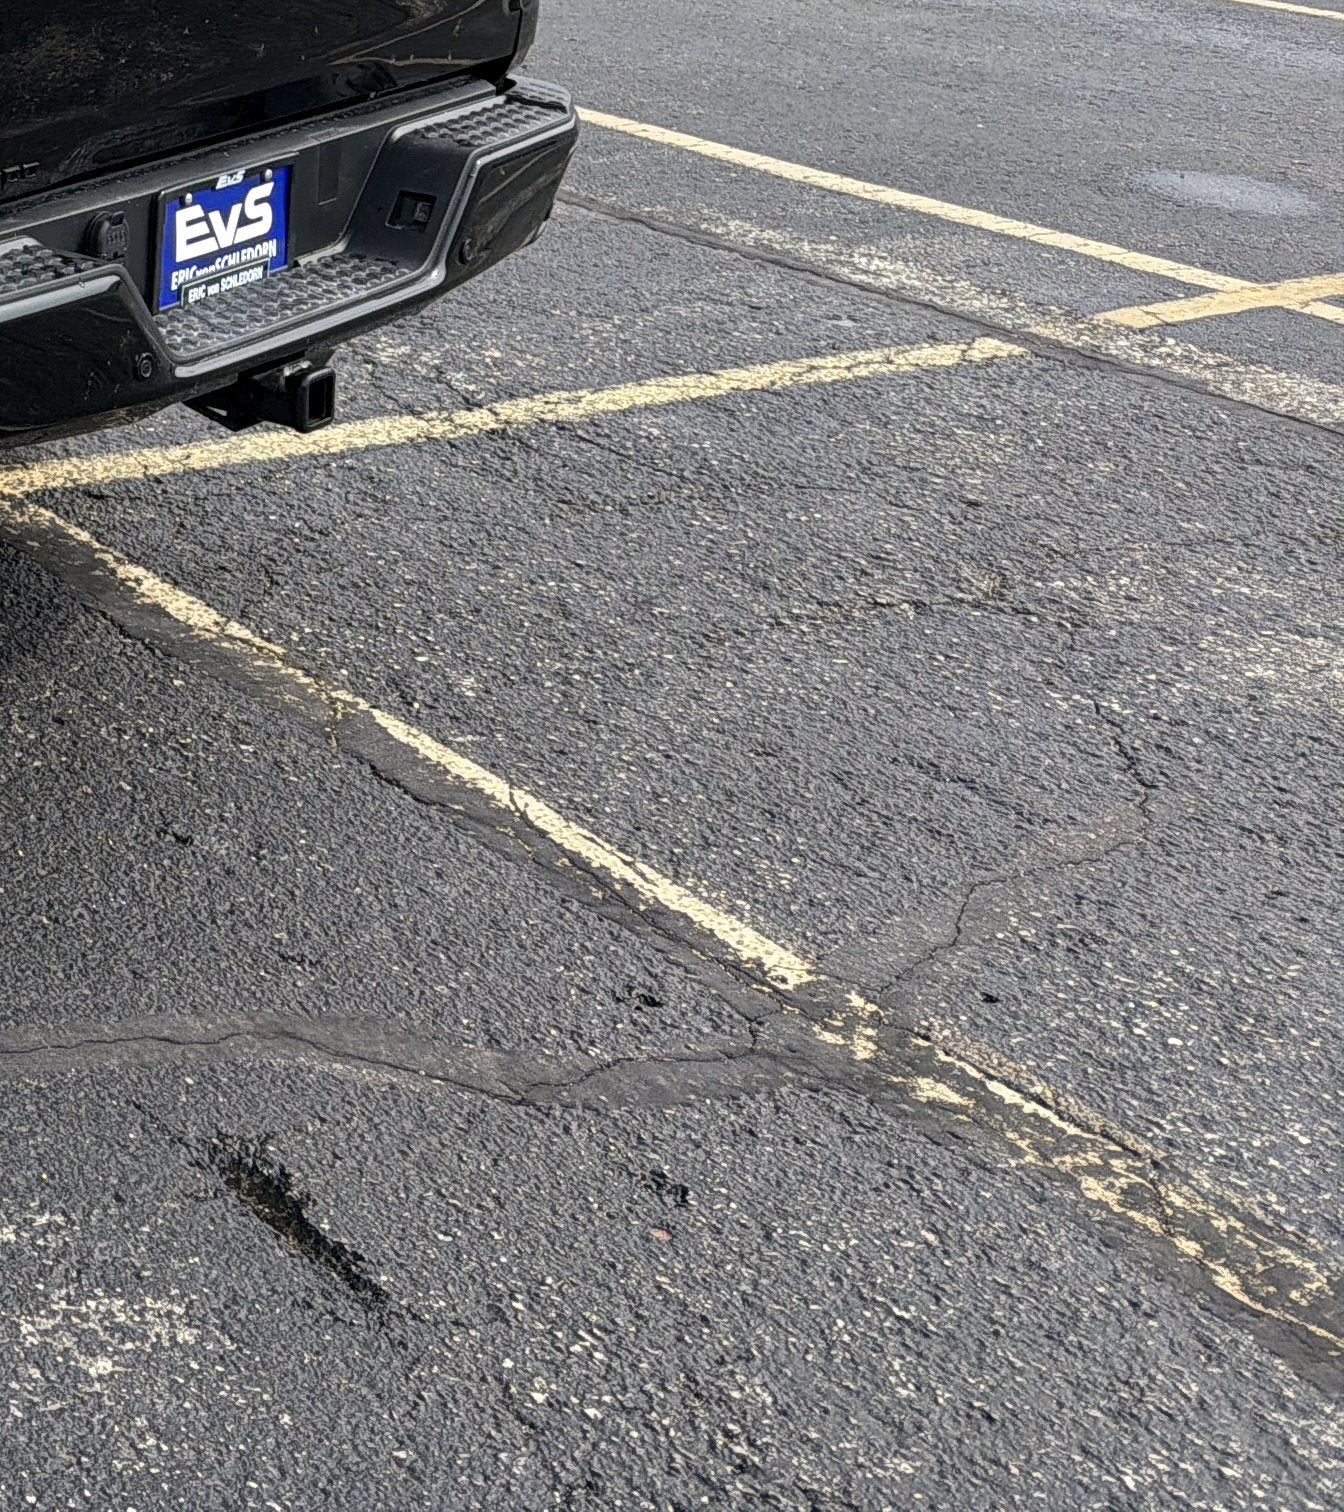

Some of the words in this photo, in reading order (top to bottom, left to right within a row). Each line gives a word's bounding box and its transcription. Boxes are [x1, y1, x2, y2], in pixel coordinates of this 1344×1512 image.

[171, 265, 197, 291] ERIC
[188, 284, 206, 304] ERIC
[220, 266, 264, 292] SCHLEDORN
